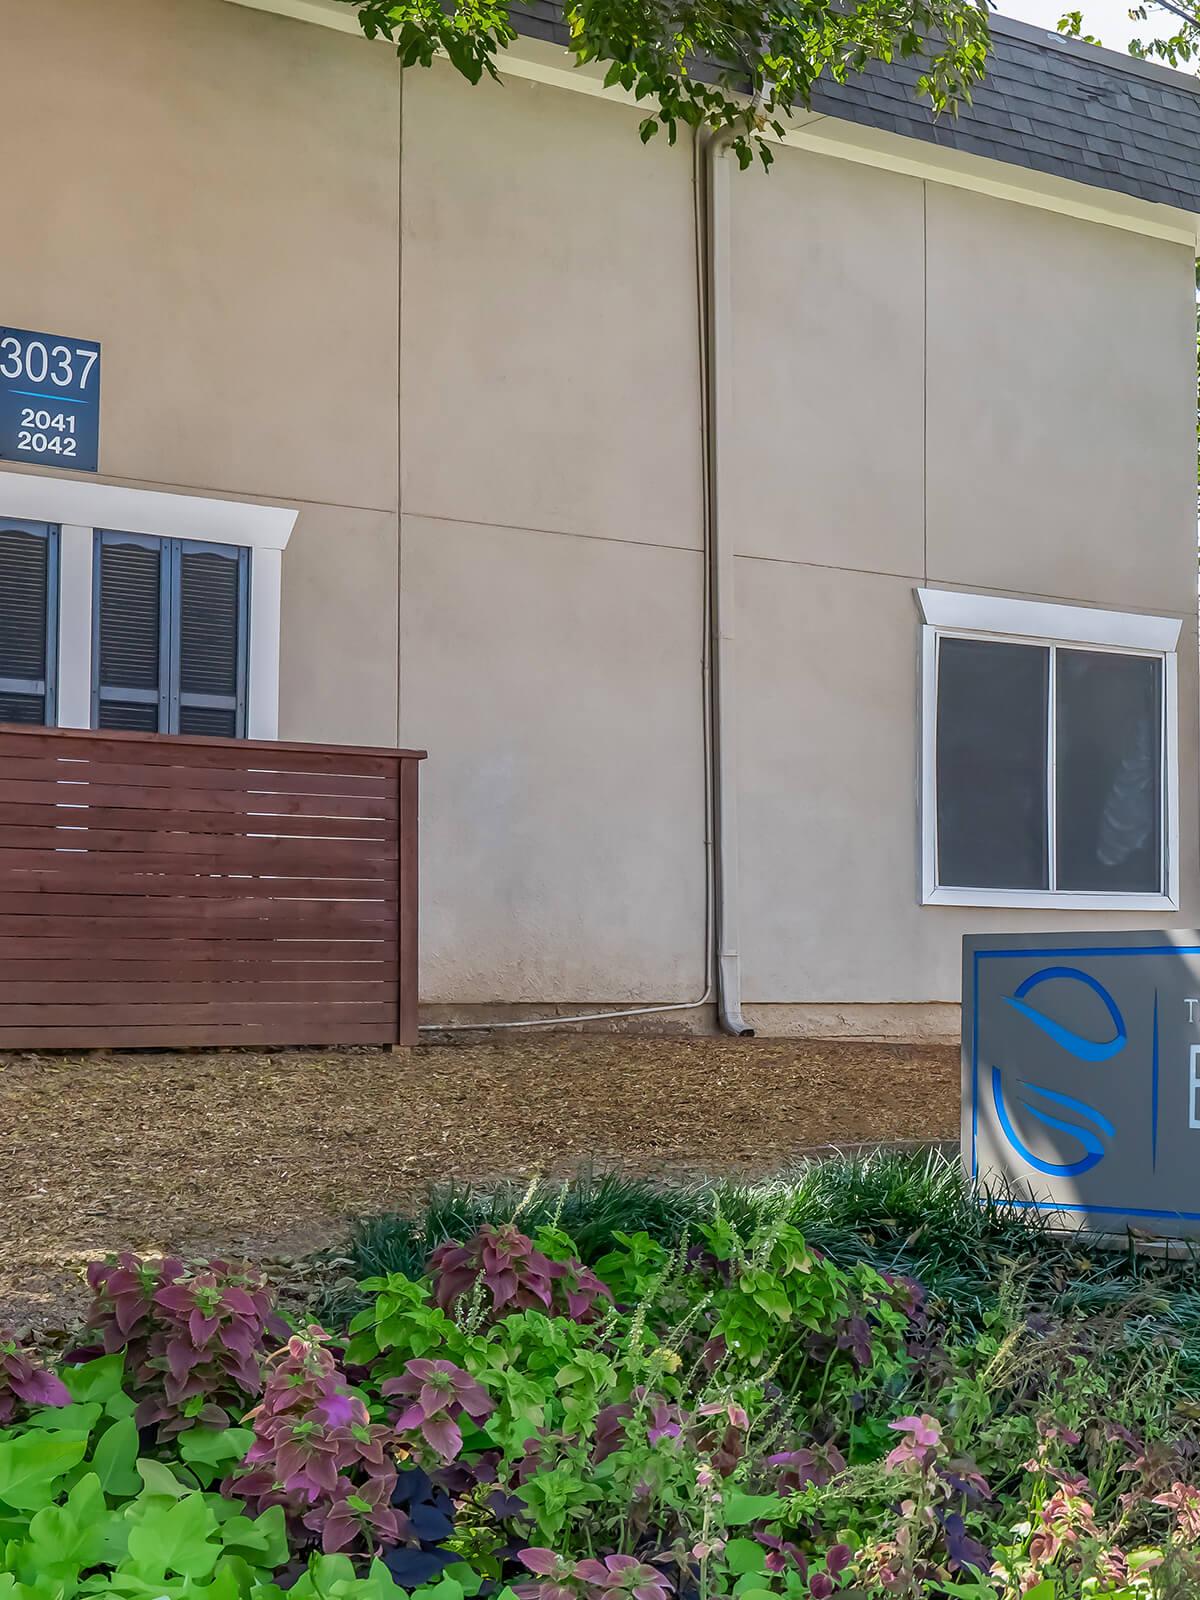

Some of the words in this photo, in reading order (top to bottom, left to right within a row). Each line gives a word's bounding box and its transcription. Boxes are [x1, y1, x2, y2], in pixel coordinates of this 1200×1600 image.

[0, 337, 98, 389] 3037
[21, 408, 76, 434] 2041
[17, 431, 77, 457] 2042
